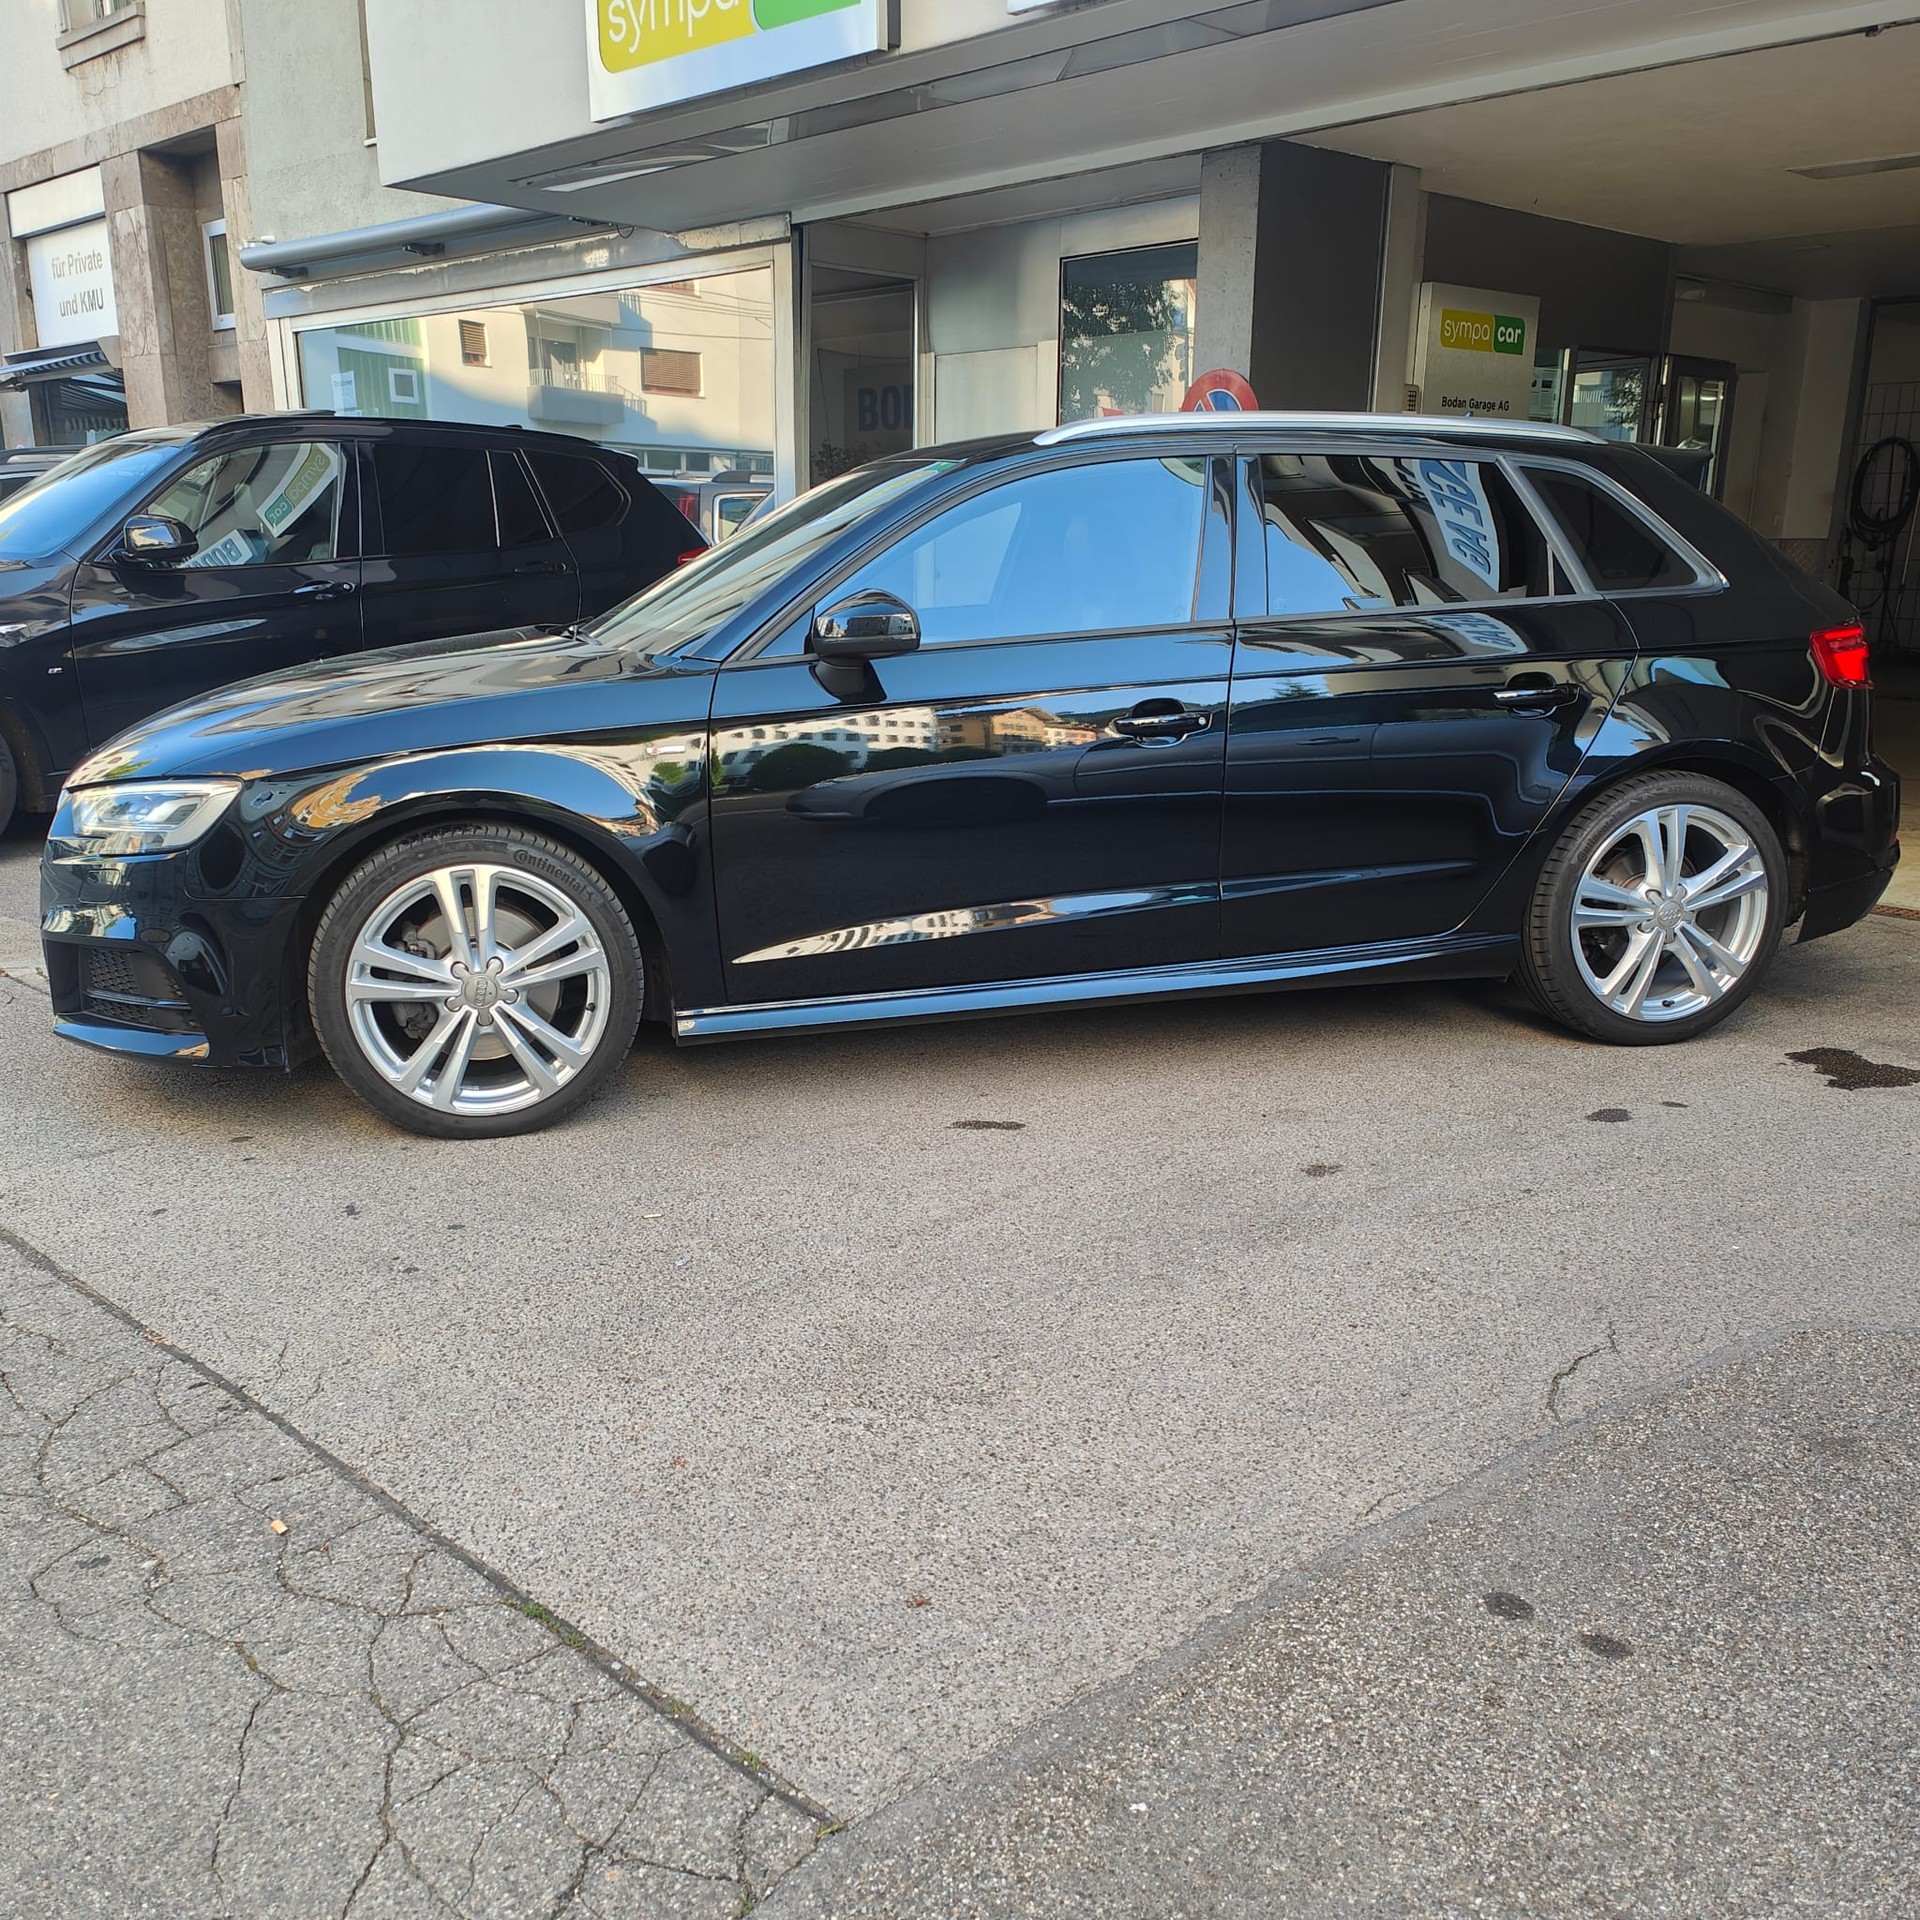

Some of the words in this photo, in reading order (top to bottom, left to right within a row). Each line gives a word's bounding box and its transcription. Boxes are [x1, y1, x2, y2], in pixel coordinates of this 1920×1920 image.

[608, 0, 741, 53] symp
[51, 256, 66, 279] für
[67, 248, 103, 276] Private
[60, 292, 79, 317] und
[79, 287, 104, 314] KMU
[1443, 320, 1491, 345] sympa
[1497, 325, 1522, 344] car
[1441, 396, 1467, 409] Bodan
[1468, 398, 1496, 412] Garage
[1498, 400, 1510, 411] AG
[513, 849, 587, 895] Continental
